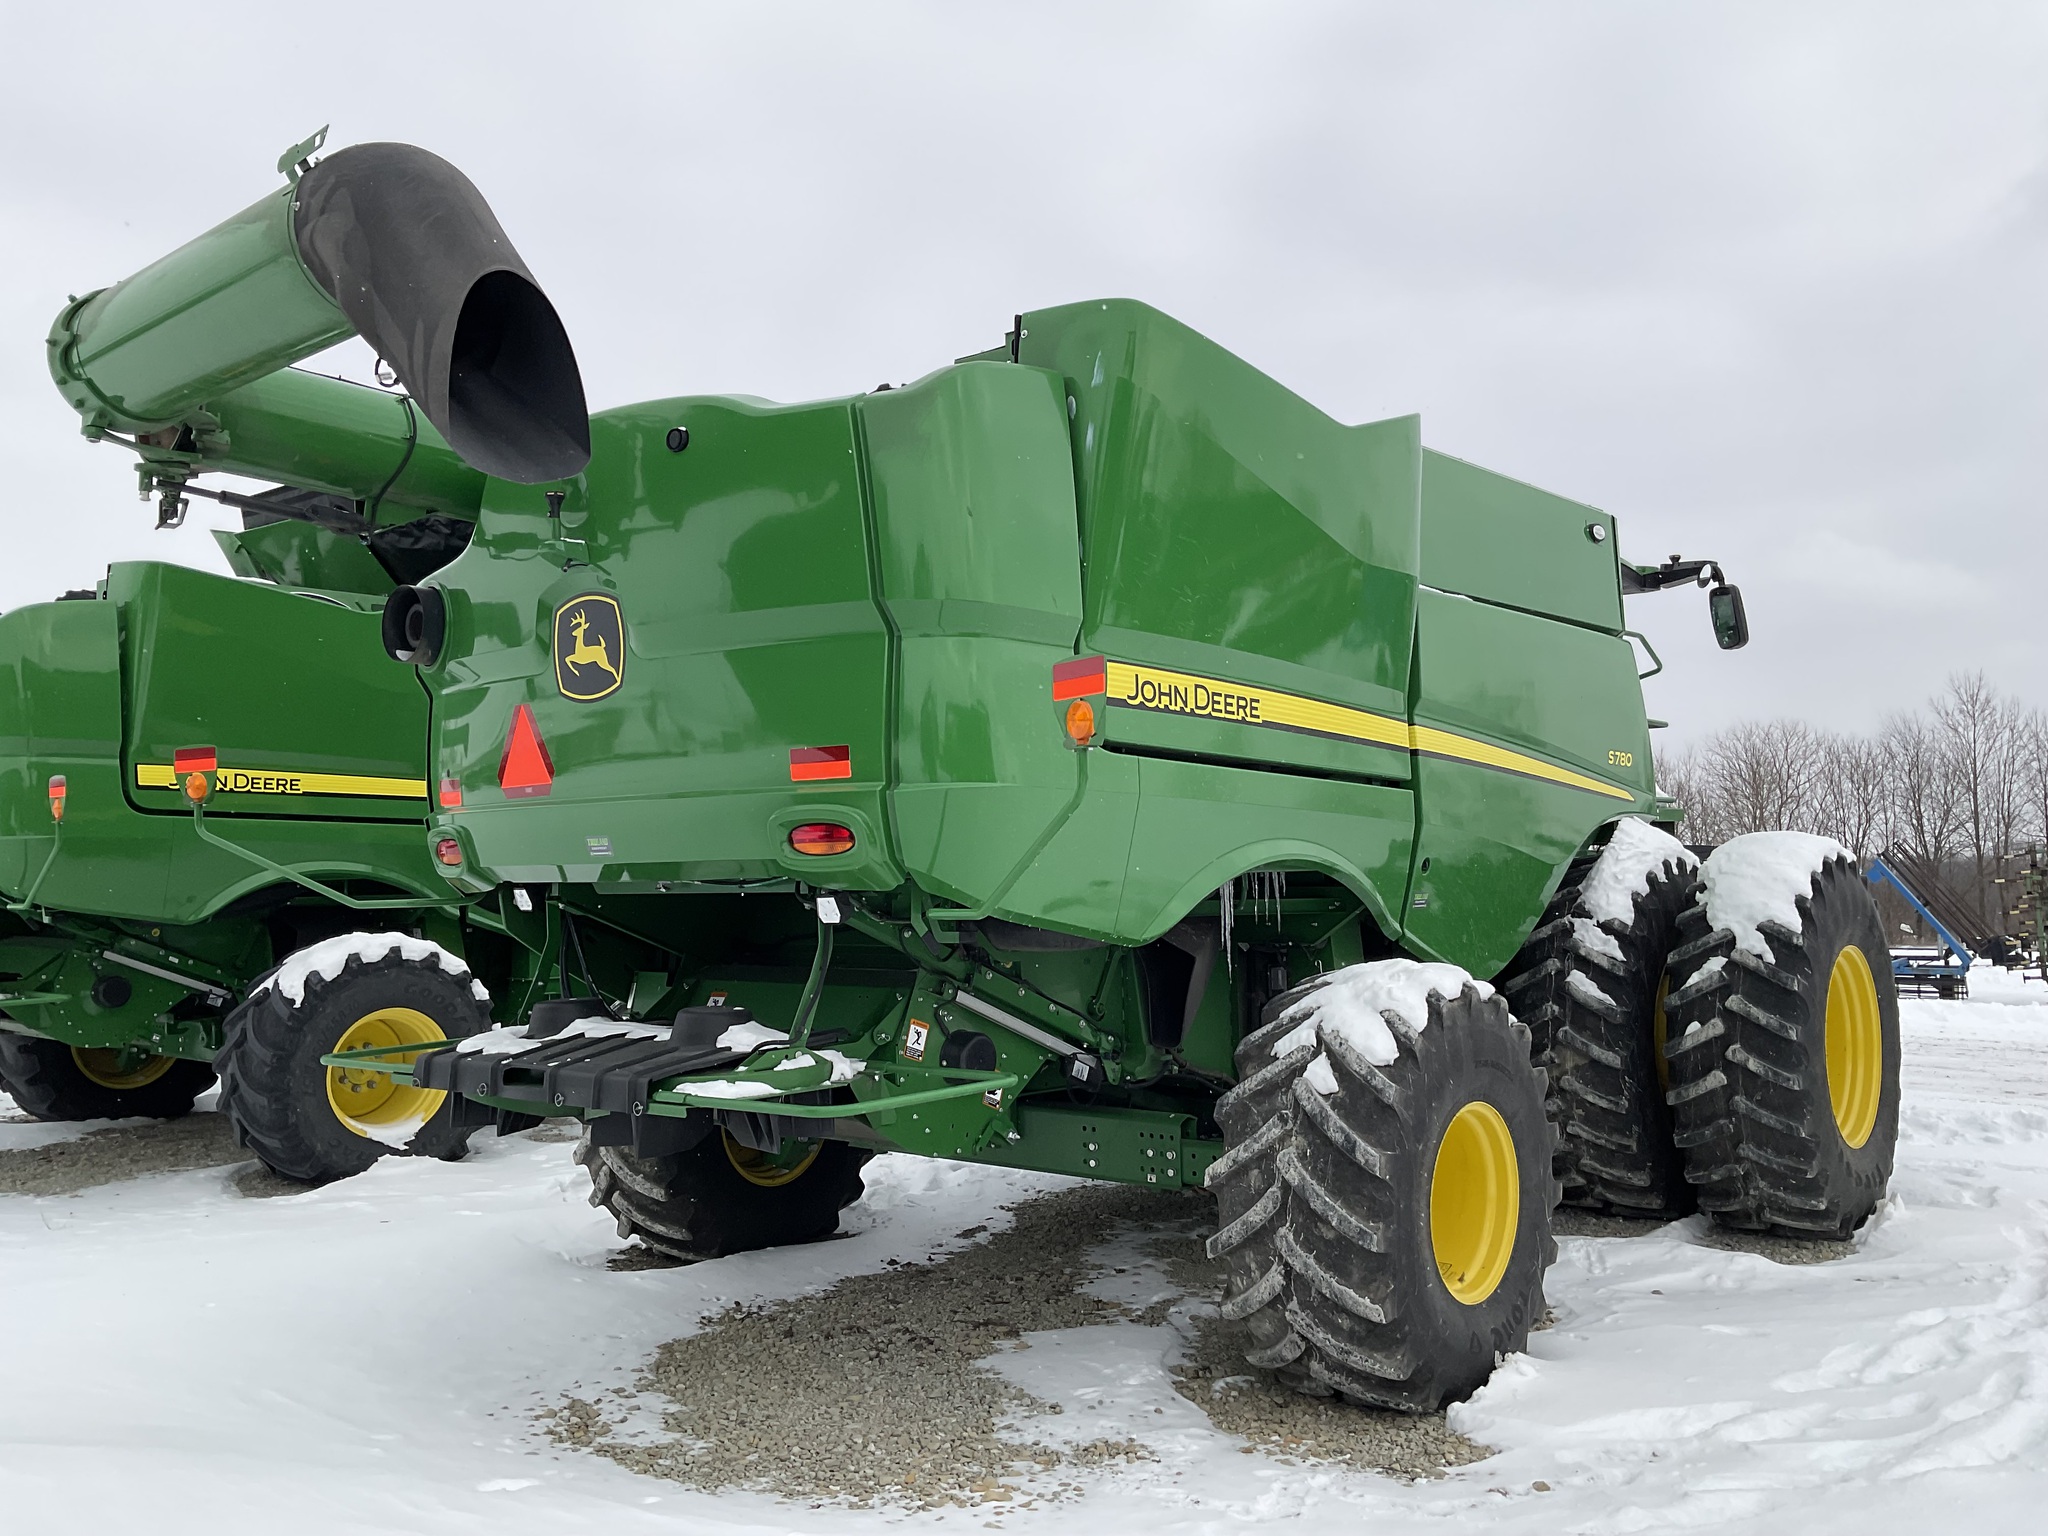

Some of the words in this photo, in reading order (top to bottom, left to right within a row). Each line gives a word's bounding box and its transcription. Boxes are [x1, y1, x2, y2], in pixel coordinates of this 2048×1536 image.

[1127, 673, 1188, 709] JOHN
[1194, 683, 1260, 719] DEERE
[1608, 750, 1633, 767] S780
[234, 773, 301, 791] DEERE
